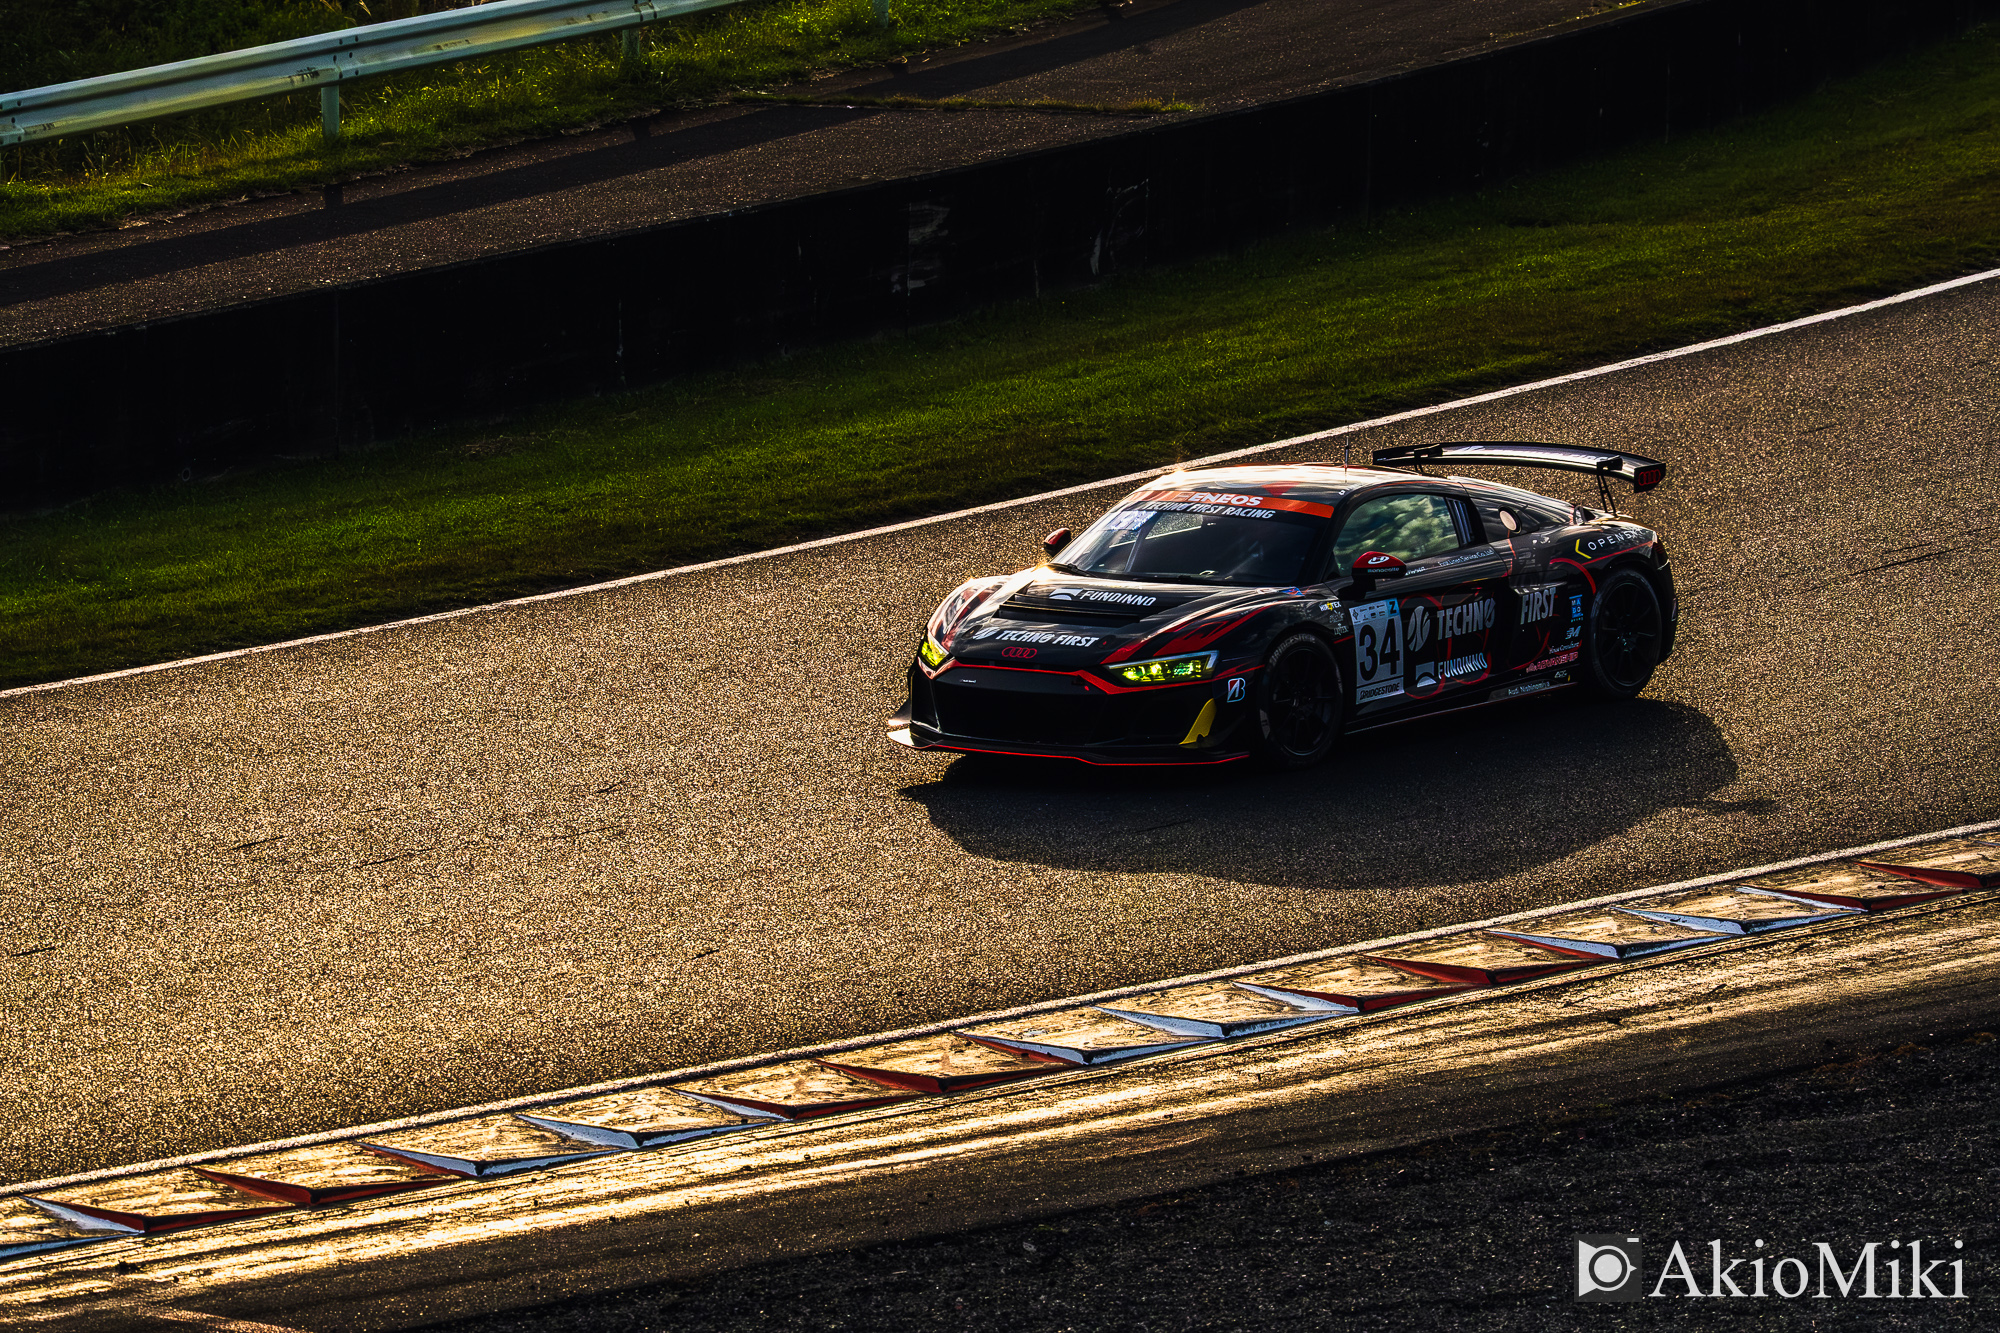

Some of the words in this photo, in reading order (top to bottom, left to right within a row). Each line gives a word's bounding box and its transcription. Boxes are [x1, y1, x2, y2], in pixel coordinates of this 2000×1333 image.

[1188, 491, 1264, 507] ENEOS
[1187, 503, 1222, 515] FIRST
[1223, 507, 1276, 519] RACING
[1079, 590, 1157, 607] FUNDINNO
[1388, 600, 1398, 615] Z
[1436, 597, 1497, 641] TECHNO
[1520, 586, 1557, 625] FIRST
[996, 629, 1051, 644] TECHNO
[1052, 634, 1100, 648] FIRST
[1358, 617, 1401, 681] 34
[1437, 652, 1488, 680] FUNDINNO
[1359, 682, 1400, 700] BRIDGESTONE
